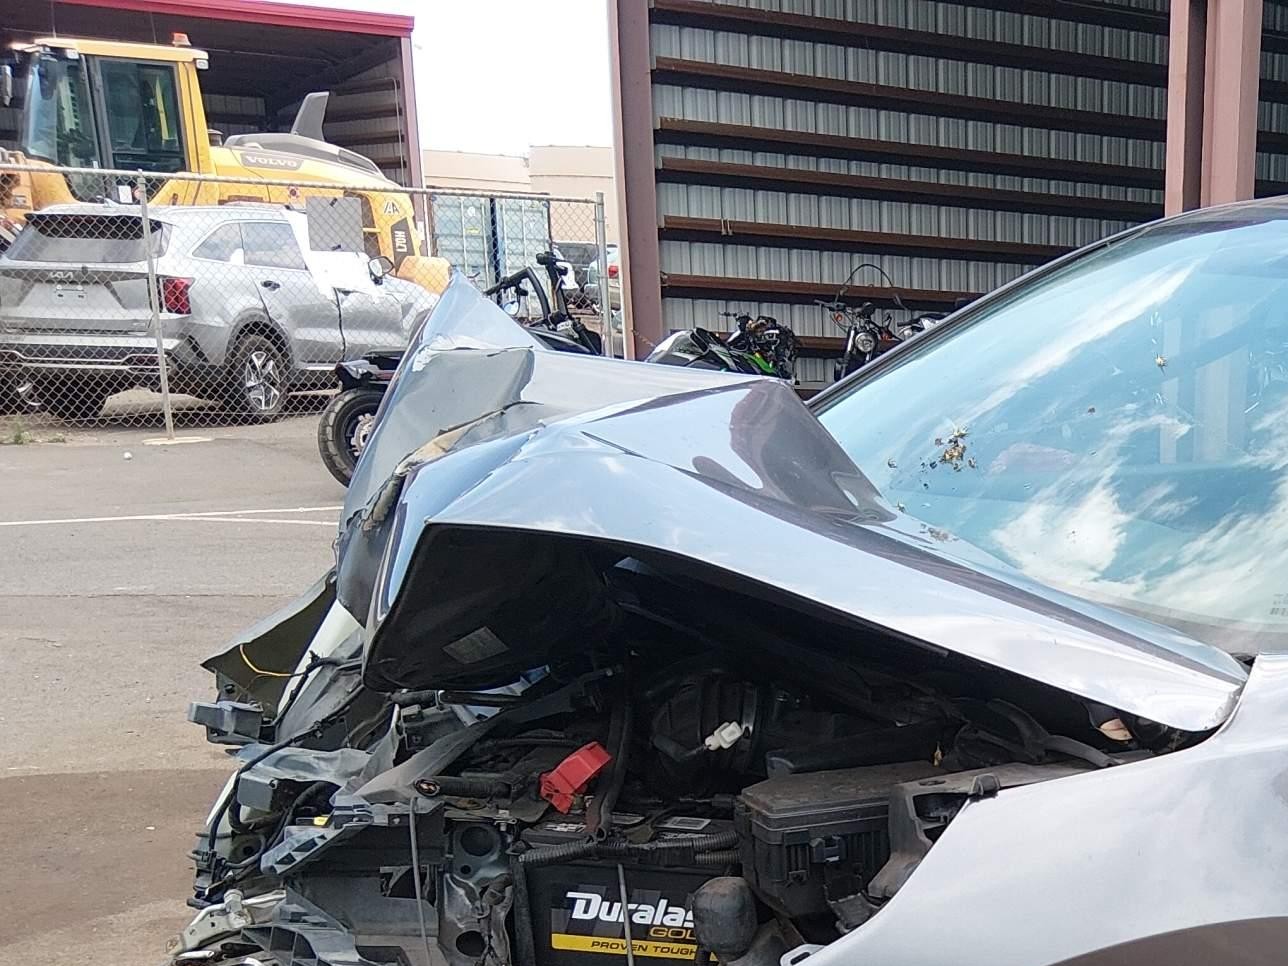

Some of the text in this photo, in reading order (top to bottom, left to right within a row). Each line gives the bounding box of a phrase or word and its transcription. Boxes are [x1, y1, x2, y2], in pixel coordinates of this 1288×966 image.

[246, 155, 297, 167] VOLVO
[566, 891, 695, 928] Duralas
[649, 926, 697, 940] GOL
[591, 940, 649, 953] PROVEN
